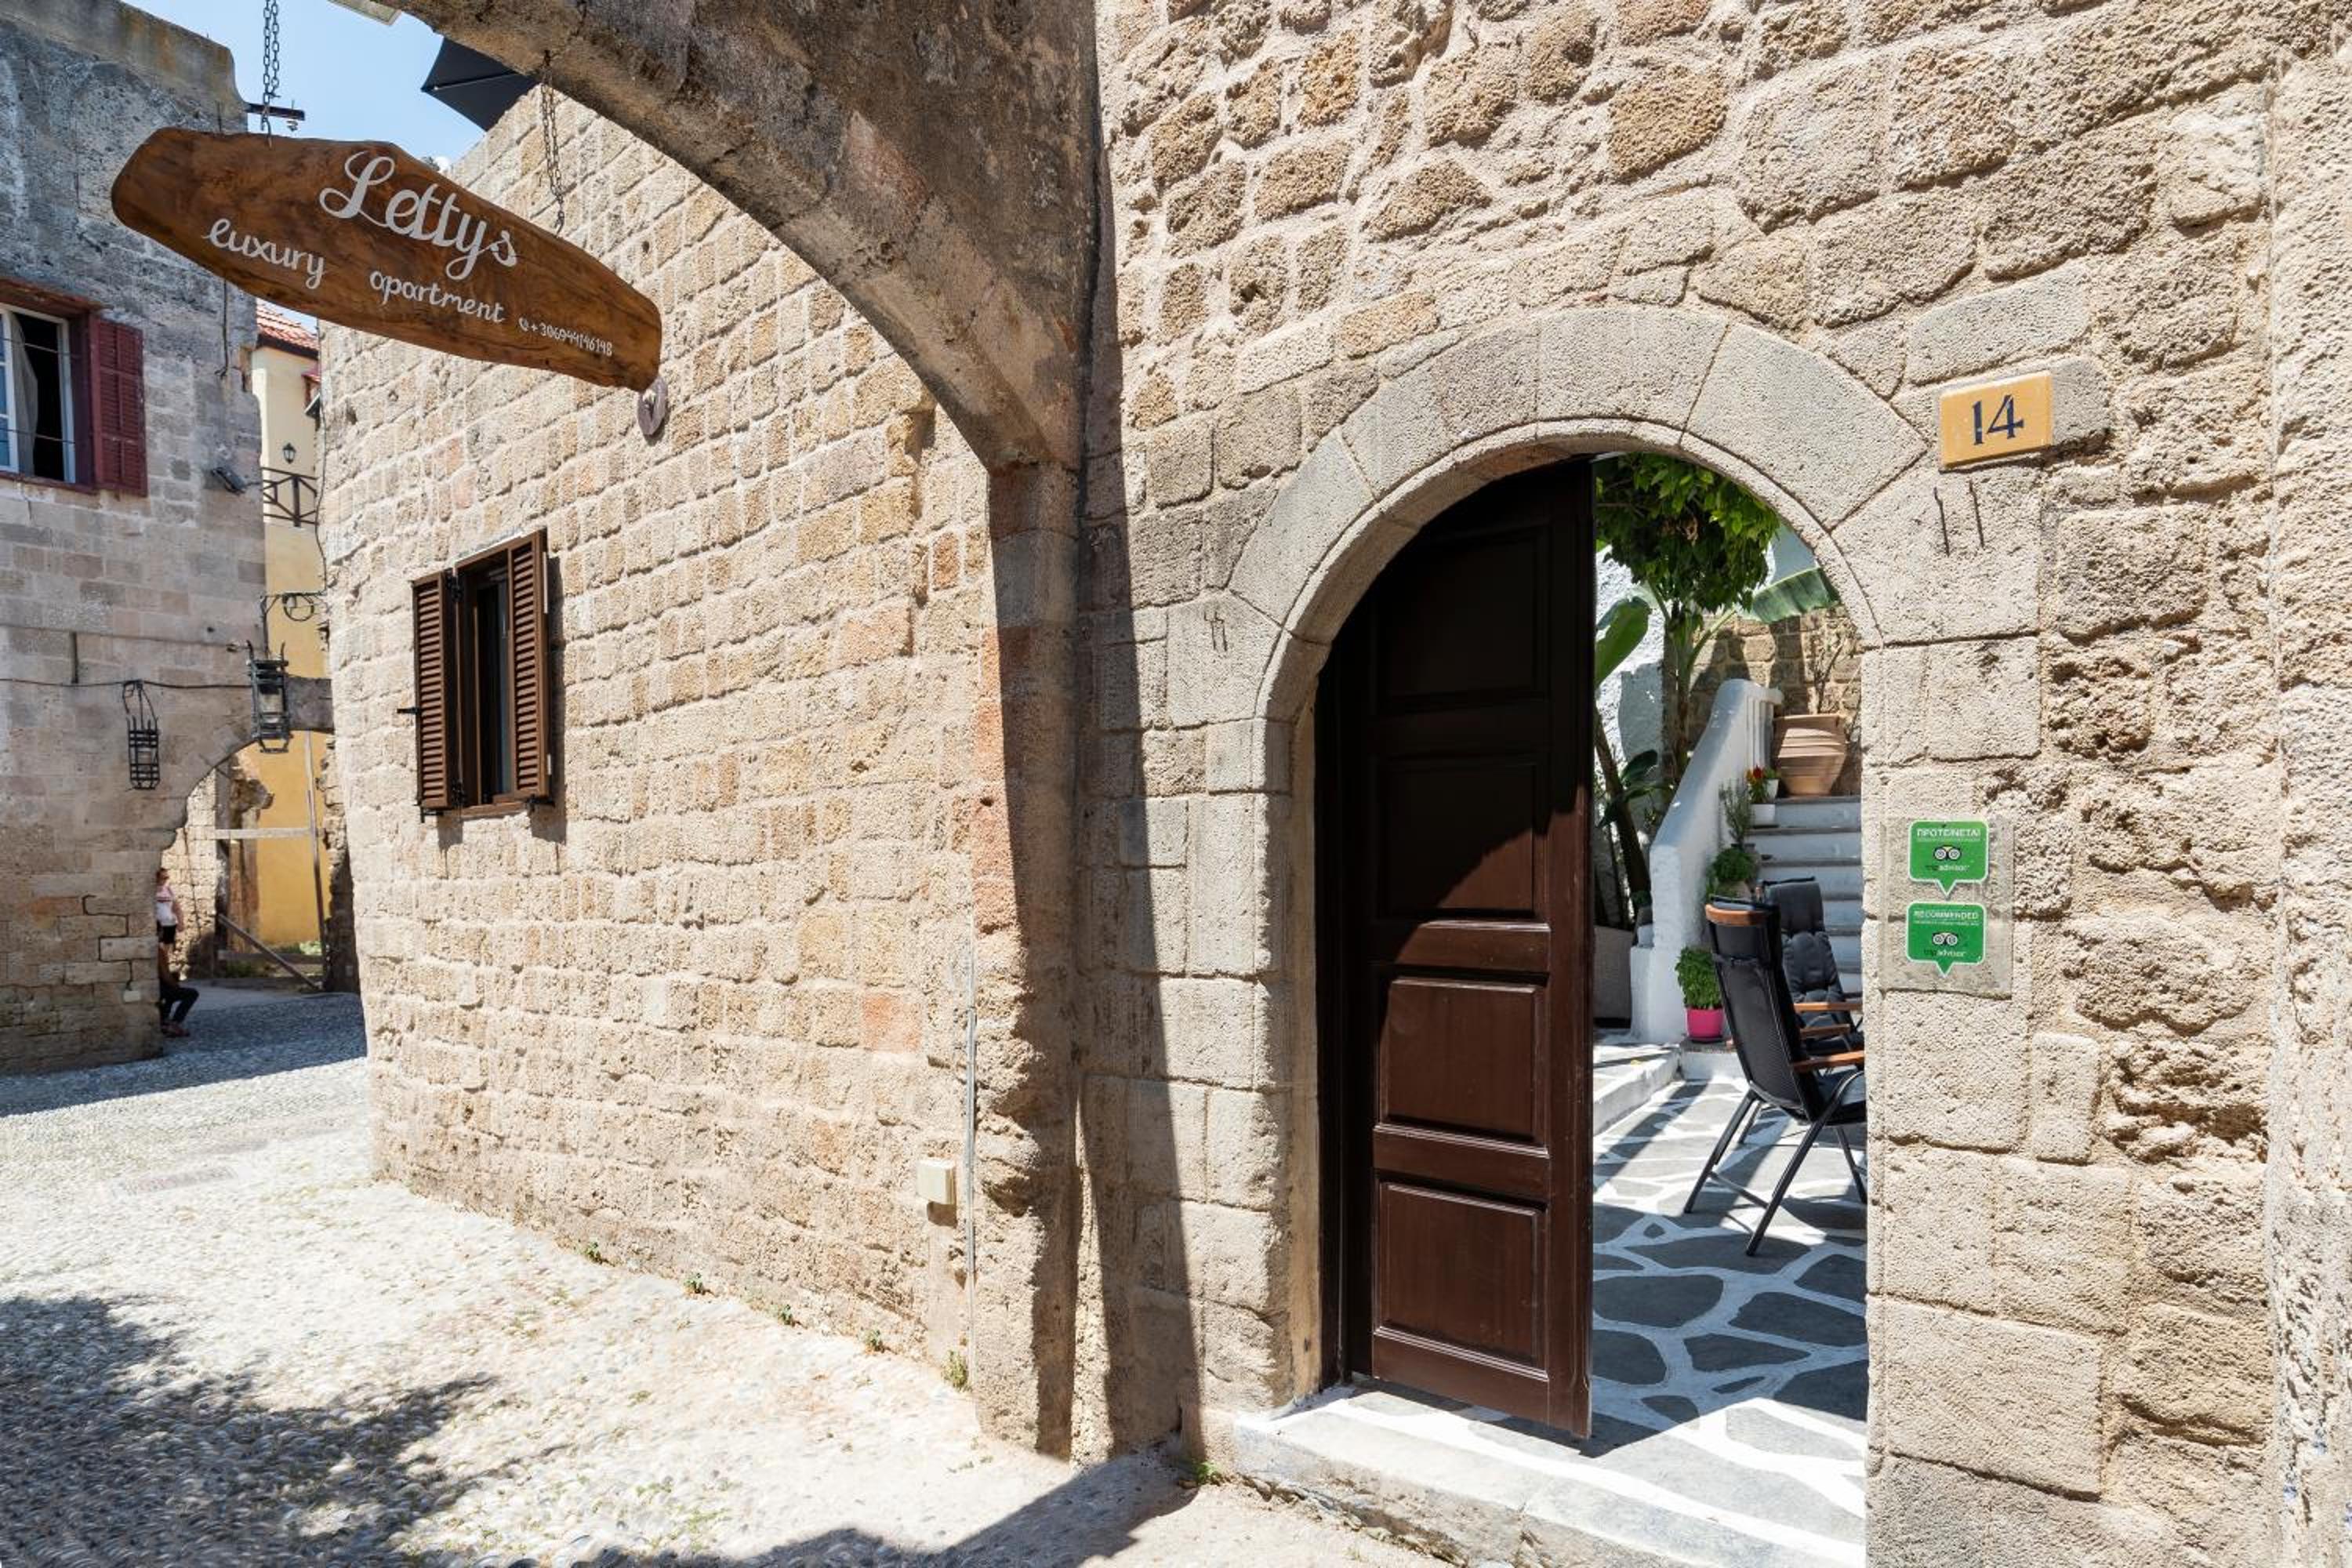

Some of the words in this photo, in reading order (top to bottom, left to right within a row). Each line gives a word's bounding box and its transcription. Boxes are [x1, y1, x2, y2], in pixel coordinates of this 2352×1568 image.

[319, 151, 517, 281] Lettys
[202, 219, 325, 289] luxury
[369, 270, 508, 324] apartment
[1972, 394, 2024, 445] 14
